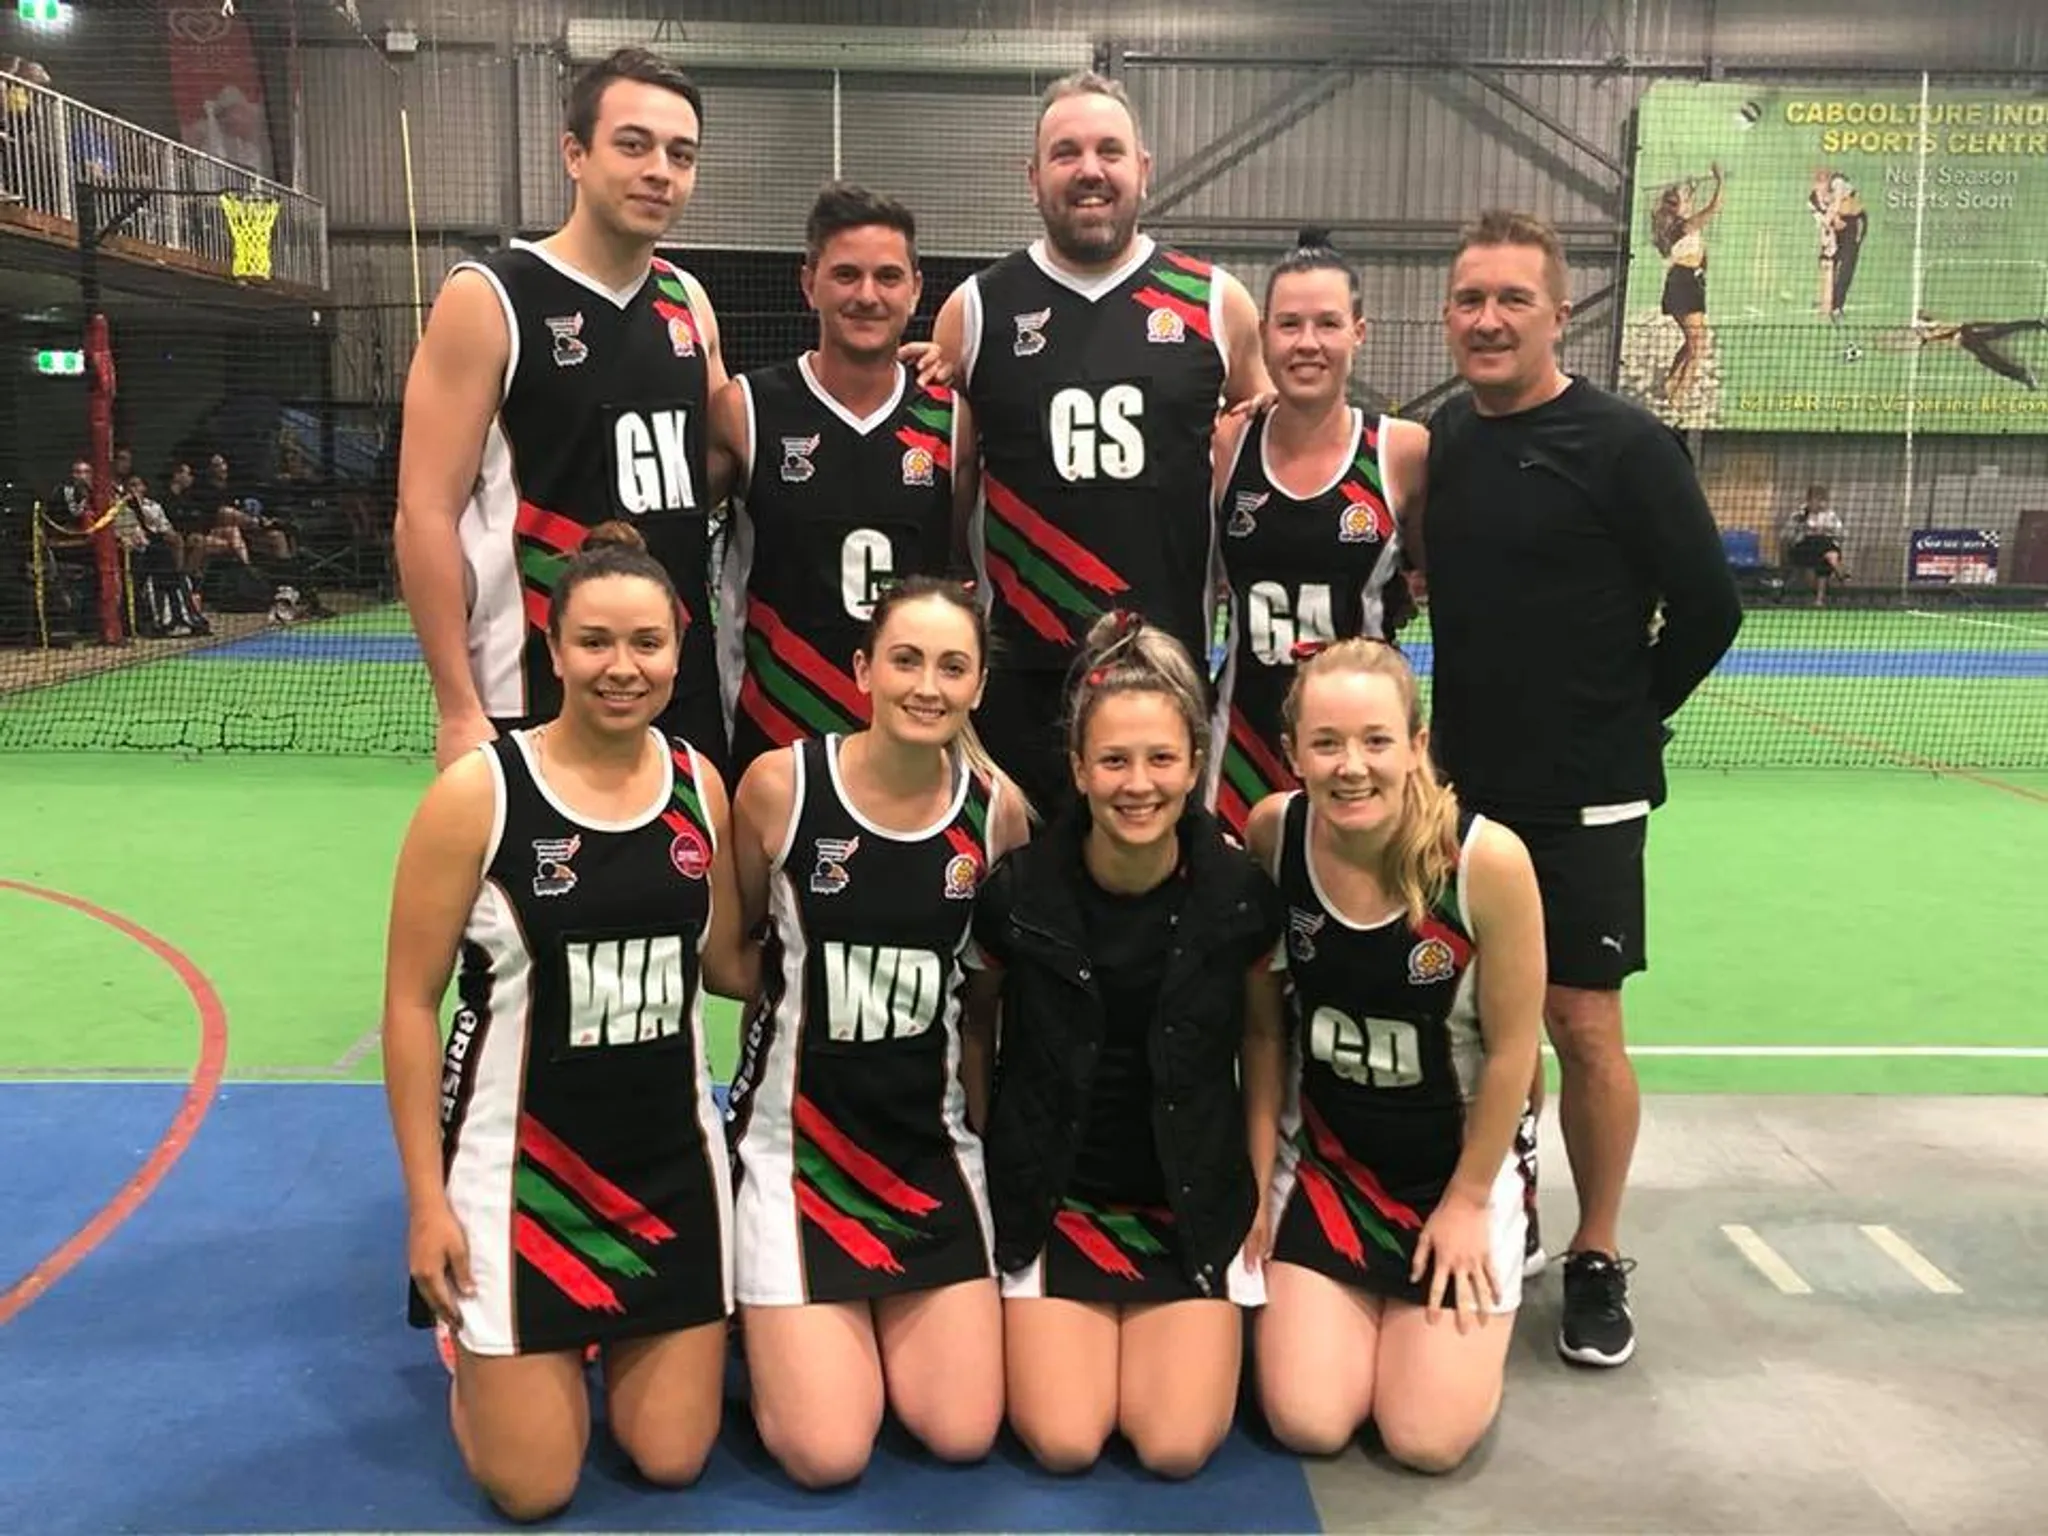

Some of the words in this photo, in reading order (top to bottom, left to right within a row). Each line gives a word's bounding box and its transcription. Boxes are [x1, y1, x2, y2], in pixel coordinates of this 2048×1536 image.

[1786, 101, 1983, 126] CABOOLTURE
[1993, 103, 2048, 126] IND
[1823, 129, 1938, 153] SPORTS
[1938, 166, 2019, 186] Season
[1955, 190, 2013, 210] Soon
[615, 409, 697, 514] GK
[1050, 384, 1145, 481] GS
[566, 935, 684, 1046] WA
[824, 941, 941, 1042] WD
[1311, 1006, 1424, 1088] GD
